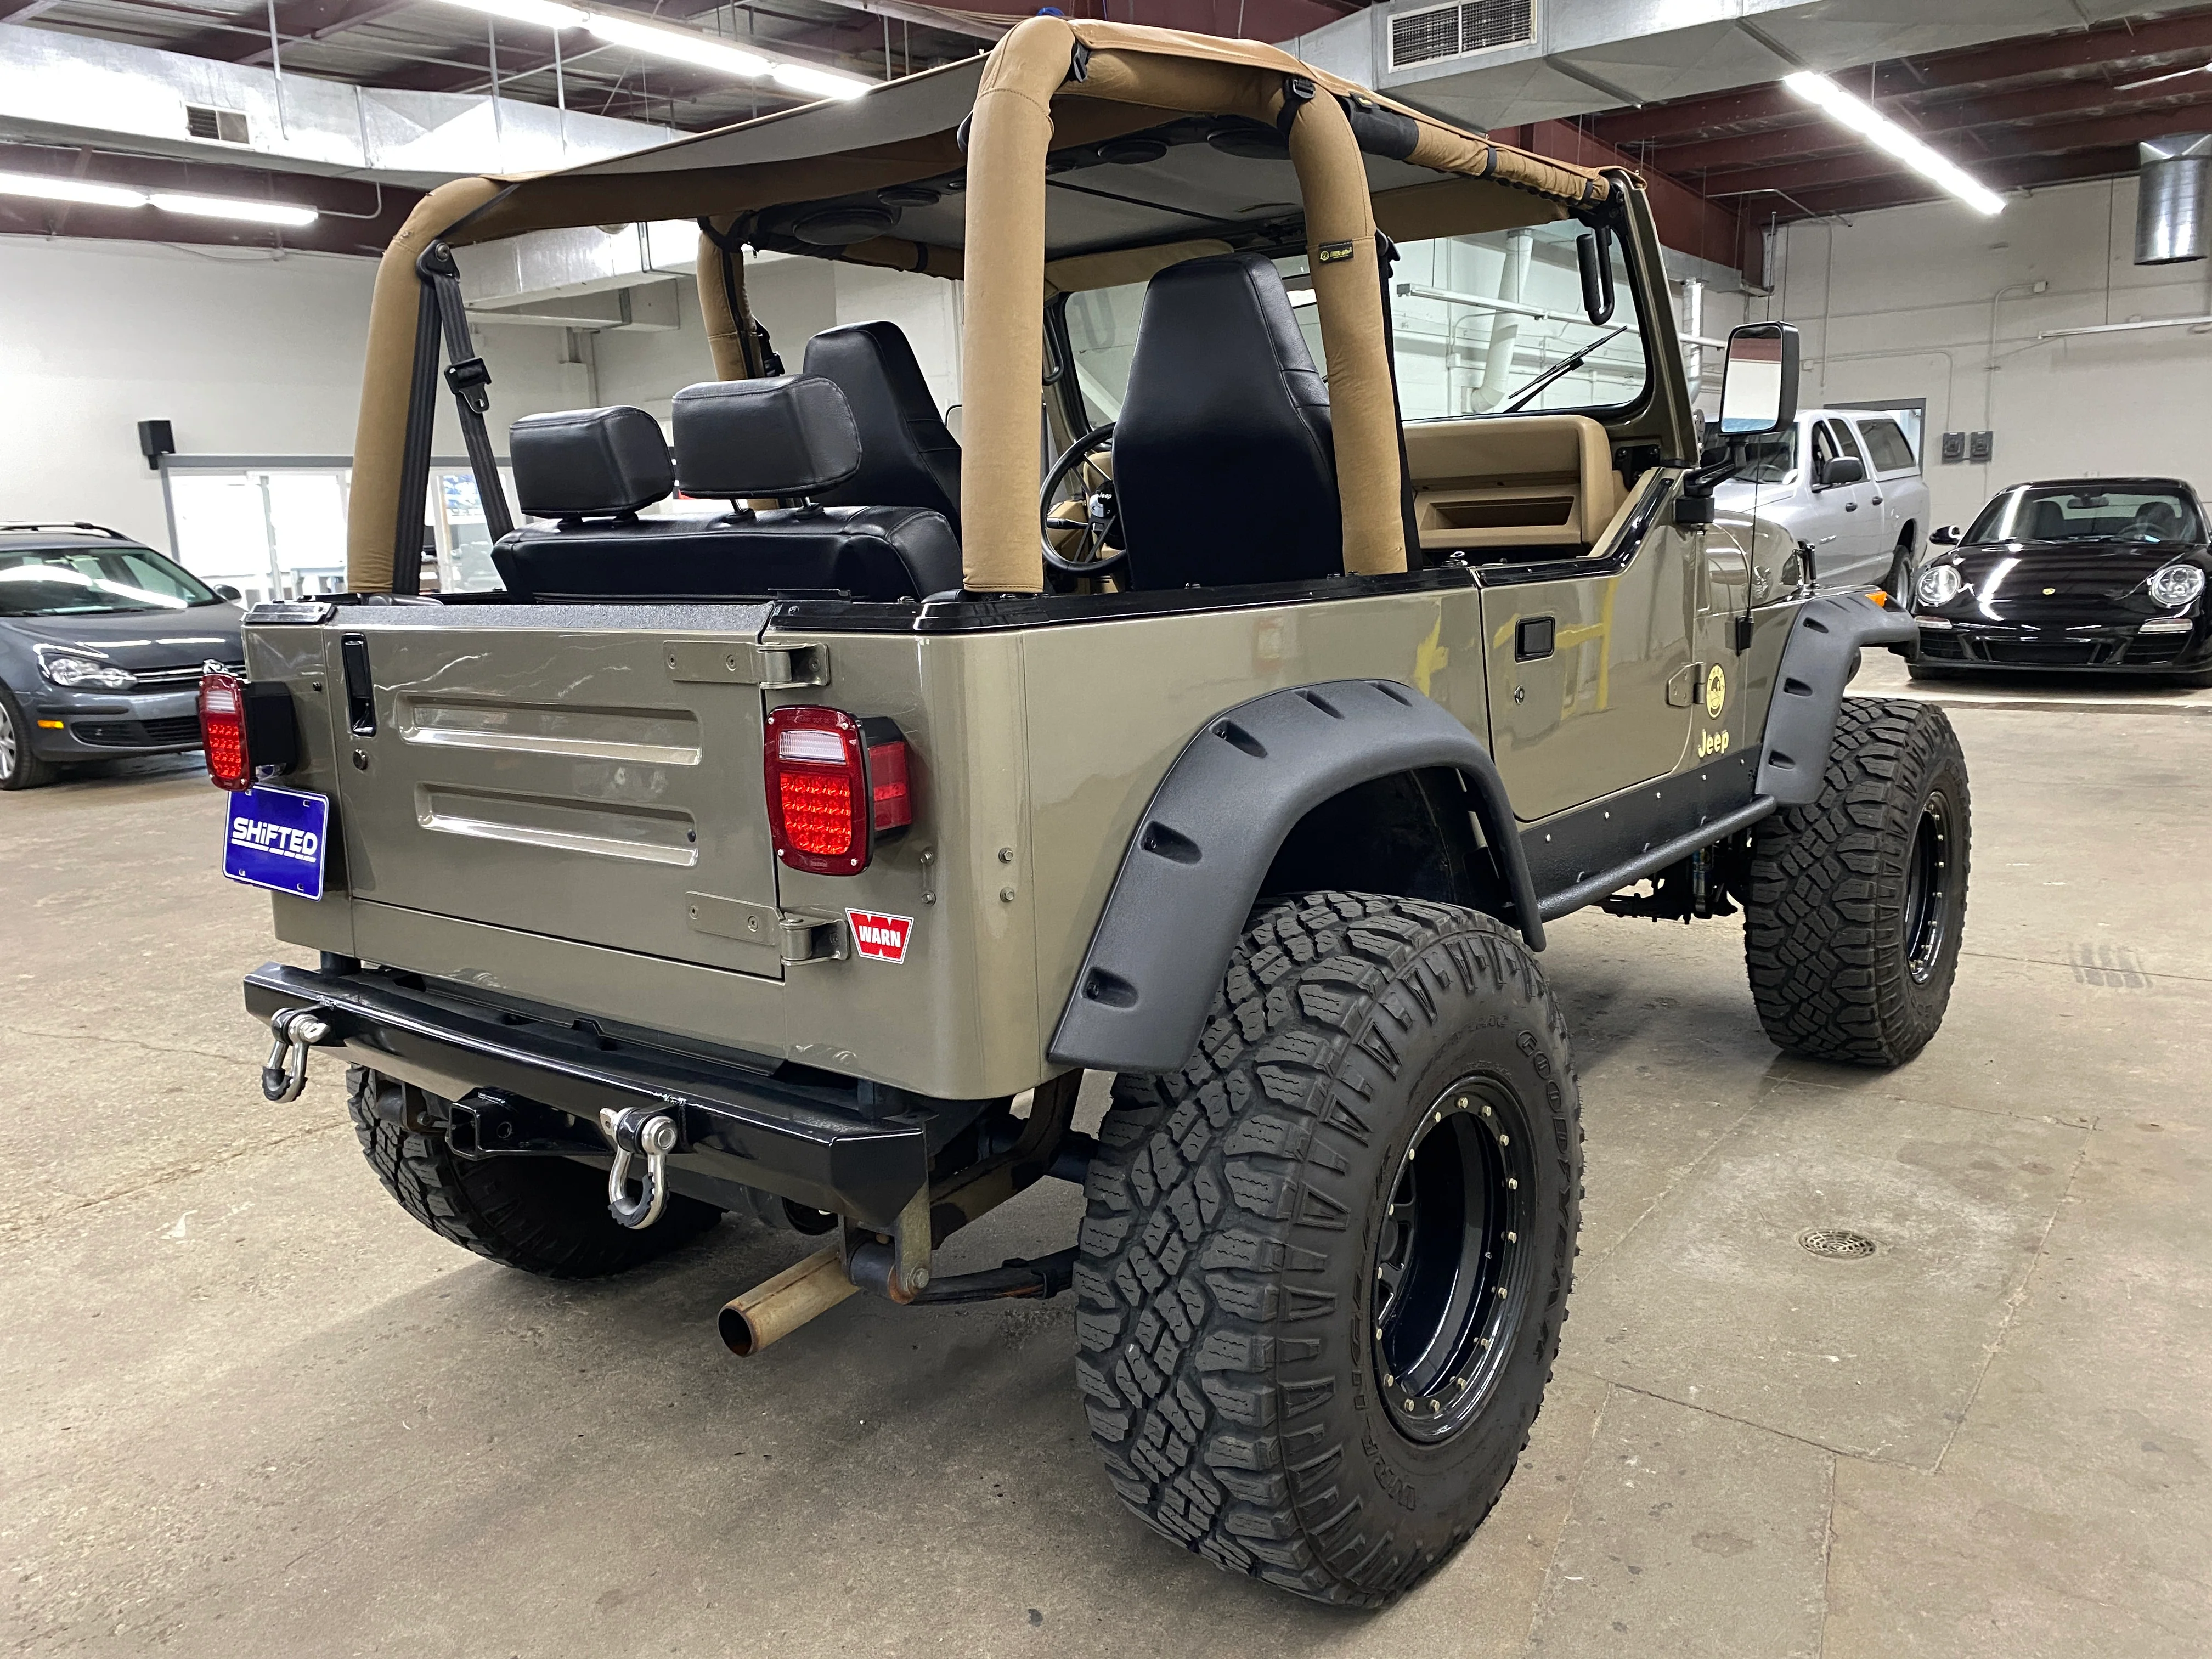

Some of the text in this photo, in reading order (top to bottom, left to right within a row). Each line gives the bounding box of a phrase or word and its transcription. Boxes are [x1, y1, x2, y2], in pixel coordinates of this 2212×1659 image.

[1698, 729, 1730, 758] Jeep
[858, 925, 901, 948] WARN
[1516, 1029, 1571, 1364] GOODYEAR
